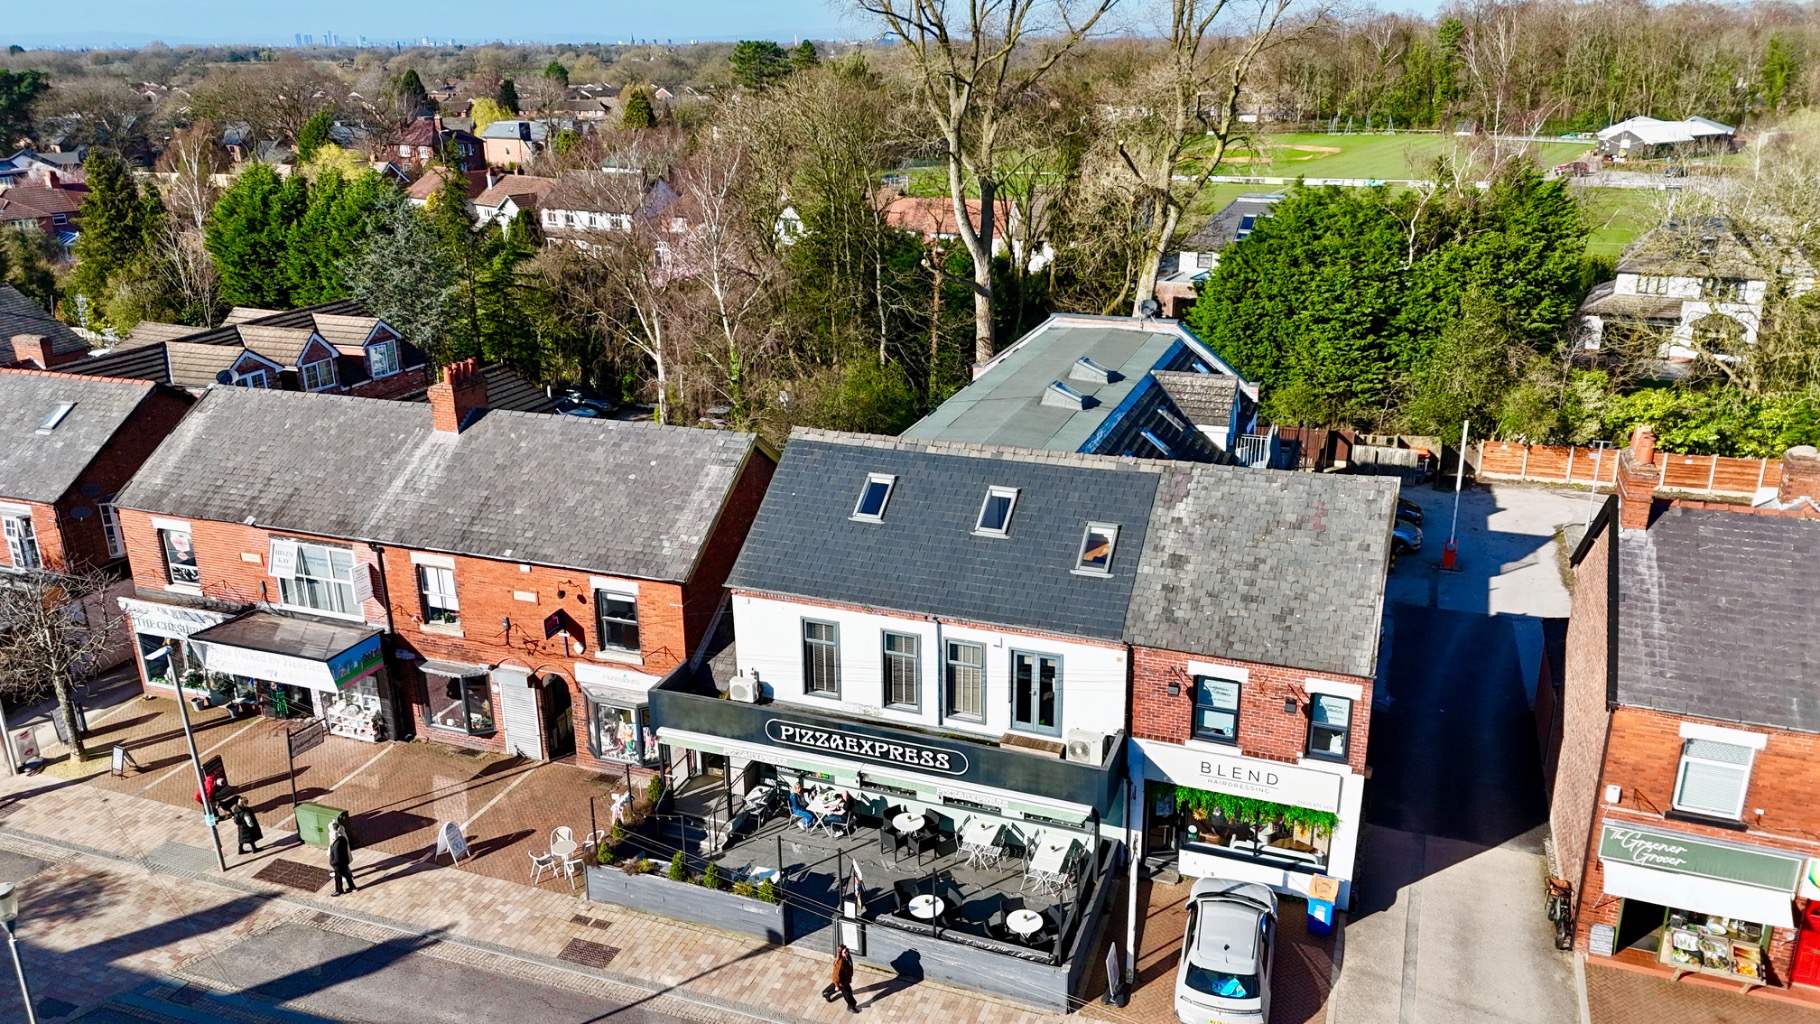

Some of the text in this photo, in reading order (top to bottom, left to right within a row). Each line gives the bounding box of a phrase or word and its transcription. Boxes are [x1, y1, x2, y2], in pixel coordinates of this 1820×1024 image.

[274, 549, 294, 557] HELEN
[136, 617, 204, 635] THE CHESHIR
[234, 648, 267, 662] Picked
[268, 653, 281, 666] by
[723, 748, 788, 765] PIZZAEXPRESS
[780, 725, 952, 769] PIZZAEXPRESS
[1200, 761, 1279, 785] BLEND
[1207, 778, 1270, 794] HAIRDRESSING
[936, 787, 1009, 808] PIZZAEXPRESS
[1610, 828, 1688, 854] The Greener
[1633, 845, 1687, 866] Grocer
